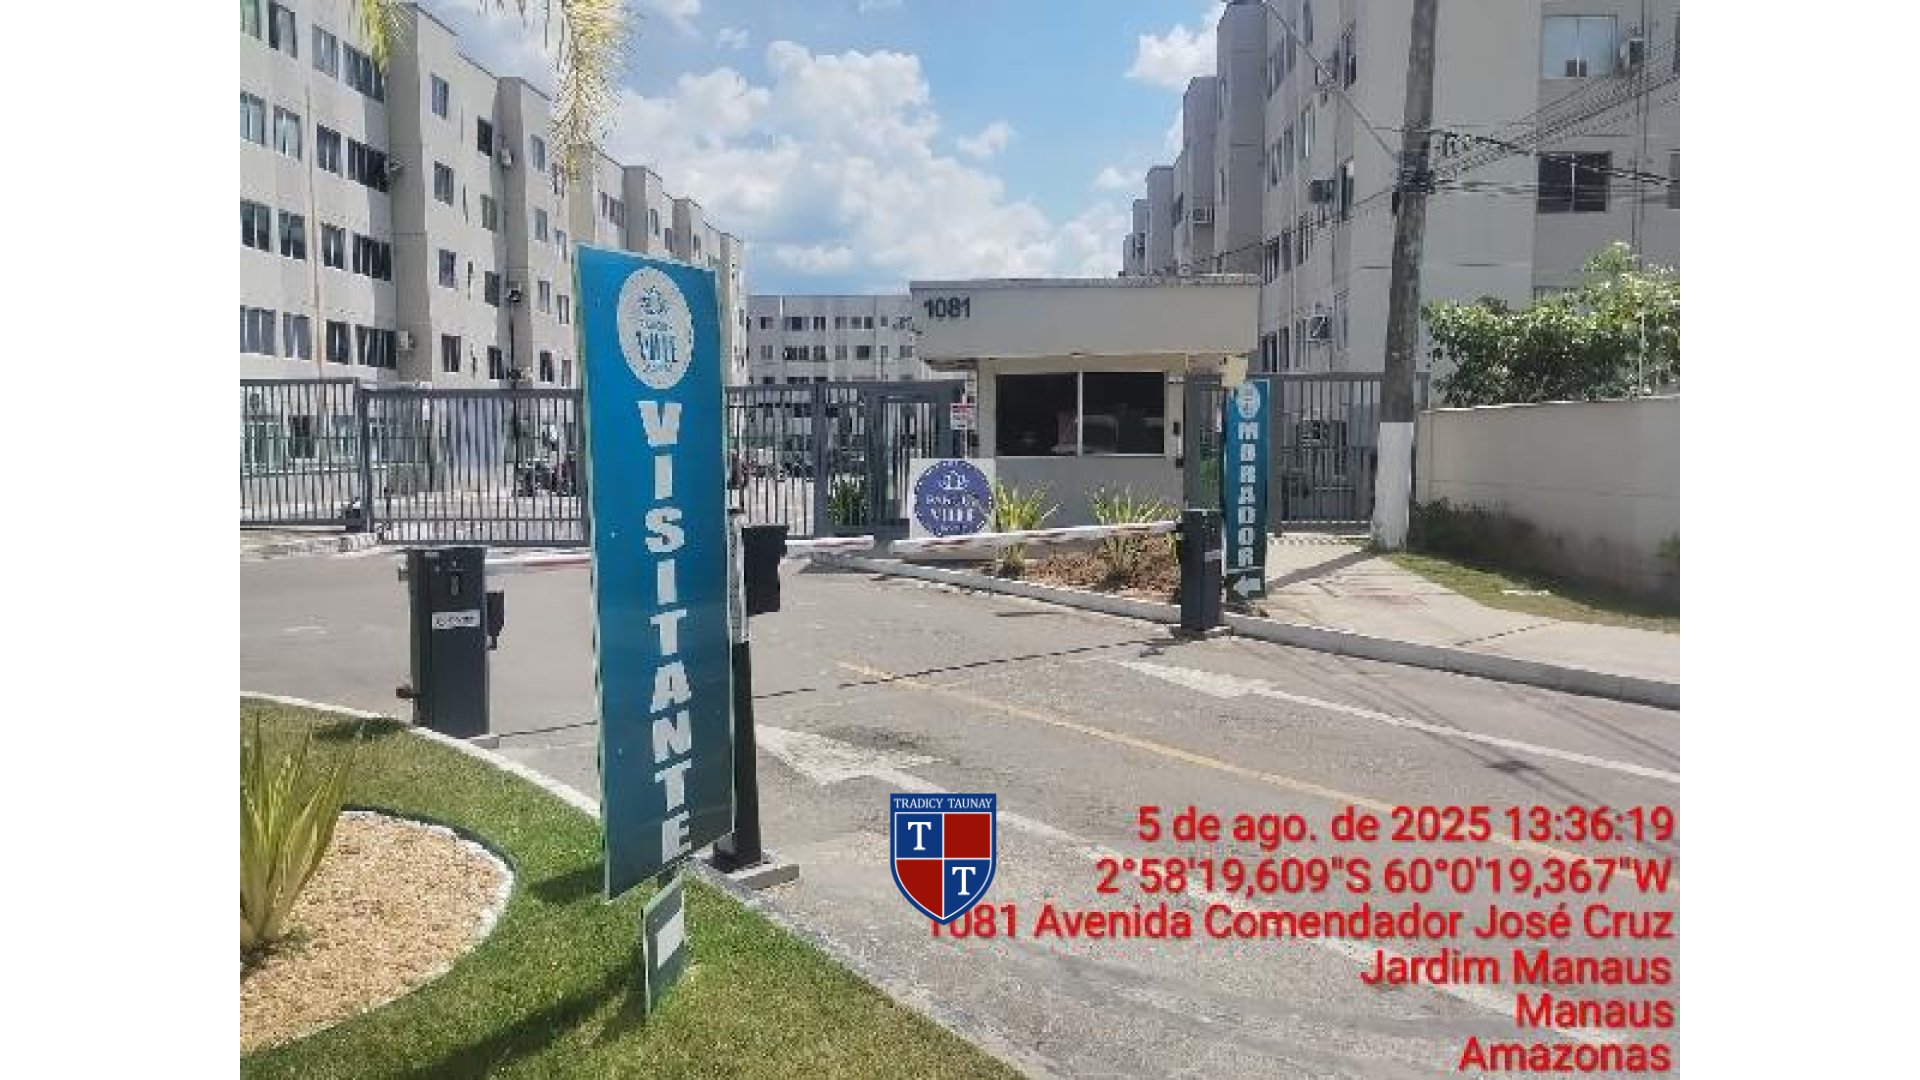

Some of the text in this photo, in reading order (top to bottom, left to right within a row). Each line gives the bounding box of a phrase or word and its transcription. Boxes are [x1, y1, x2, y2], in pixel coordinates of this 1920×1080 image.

[923, 296, 971, 319] 1081
[1237, 421, 1259, 567] MORADOR
[637, 400, 692, 864] VISITANTE
